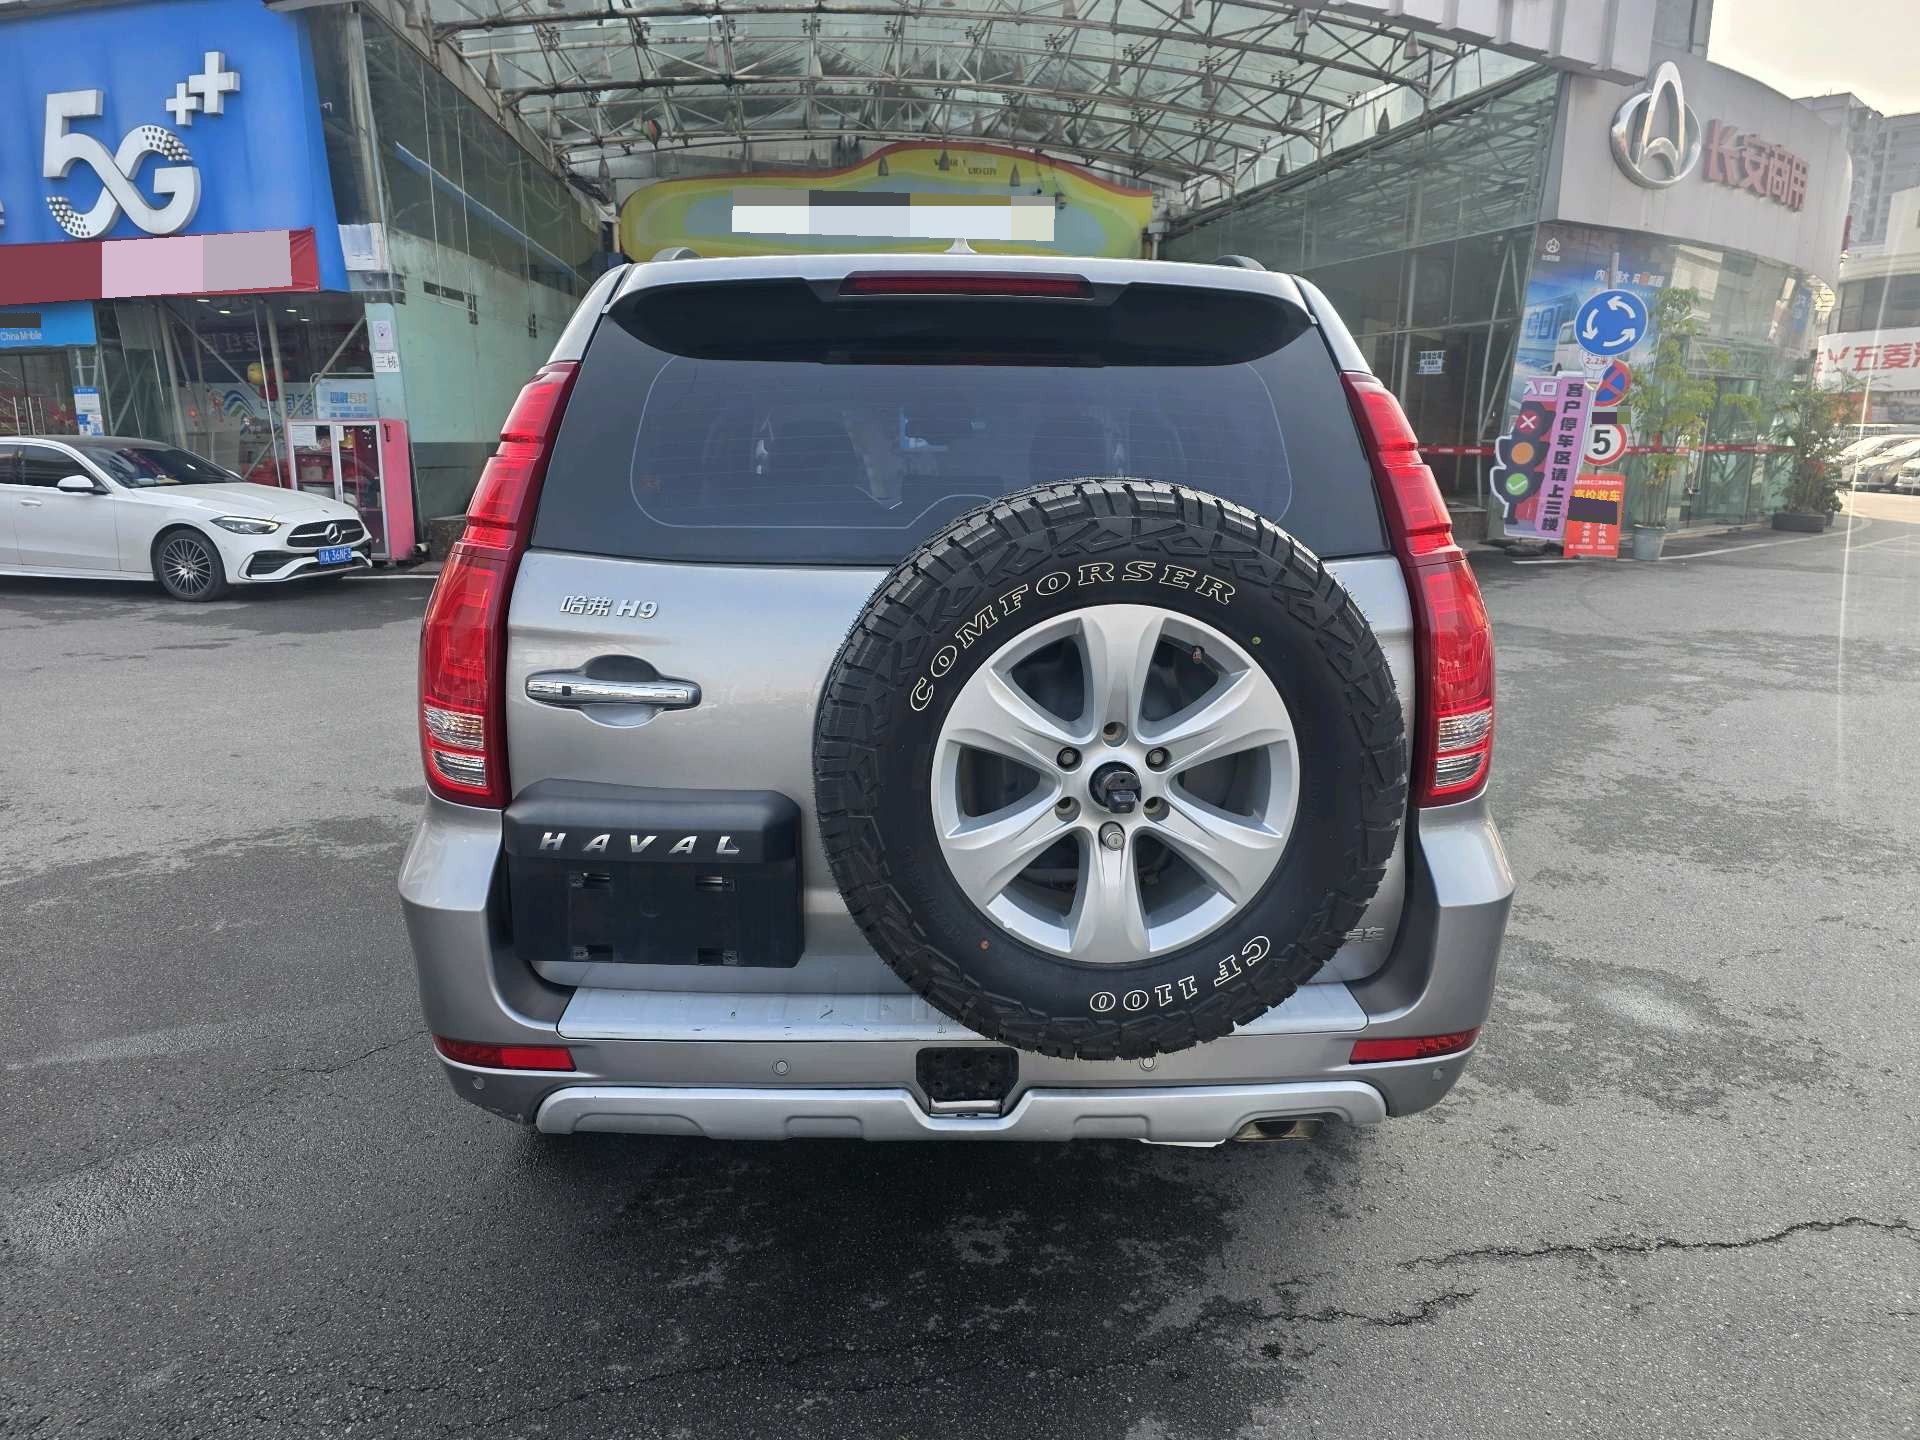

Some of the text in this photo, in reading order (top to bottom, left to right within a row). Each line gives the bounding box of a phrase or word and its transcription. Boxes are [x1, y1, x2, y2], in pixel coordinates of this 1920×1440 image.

[1702, 119, 1808, 212] 长安商用
[1523, 381, 1558, 397] 入口
[1541, 383, 1584, 532] 客户停车区请上三楼
[1592, 430, 1611, 455] 5
[559, 595, 659, 619] 哈弗 H9
[910, 560, 1236, 712] COMFORSER
[538, 832, 742, 855] HAVAL
[1089, 935, 1271, 1013] CF 1100
